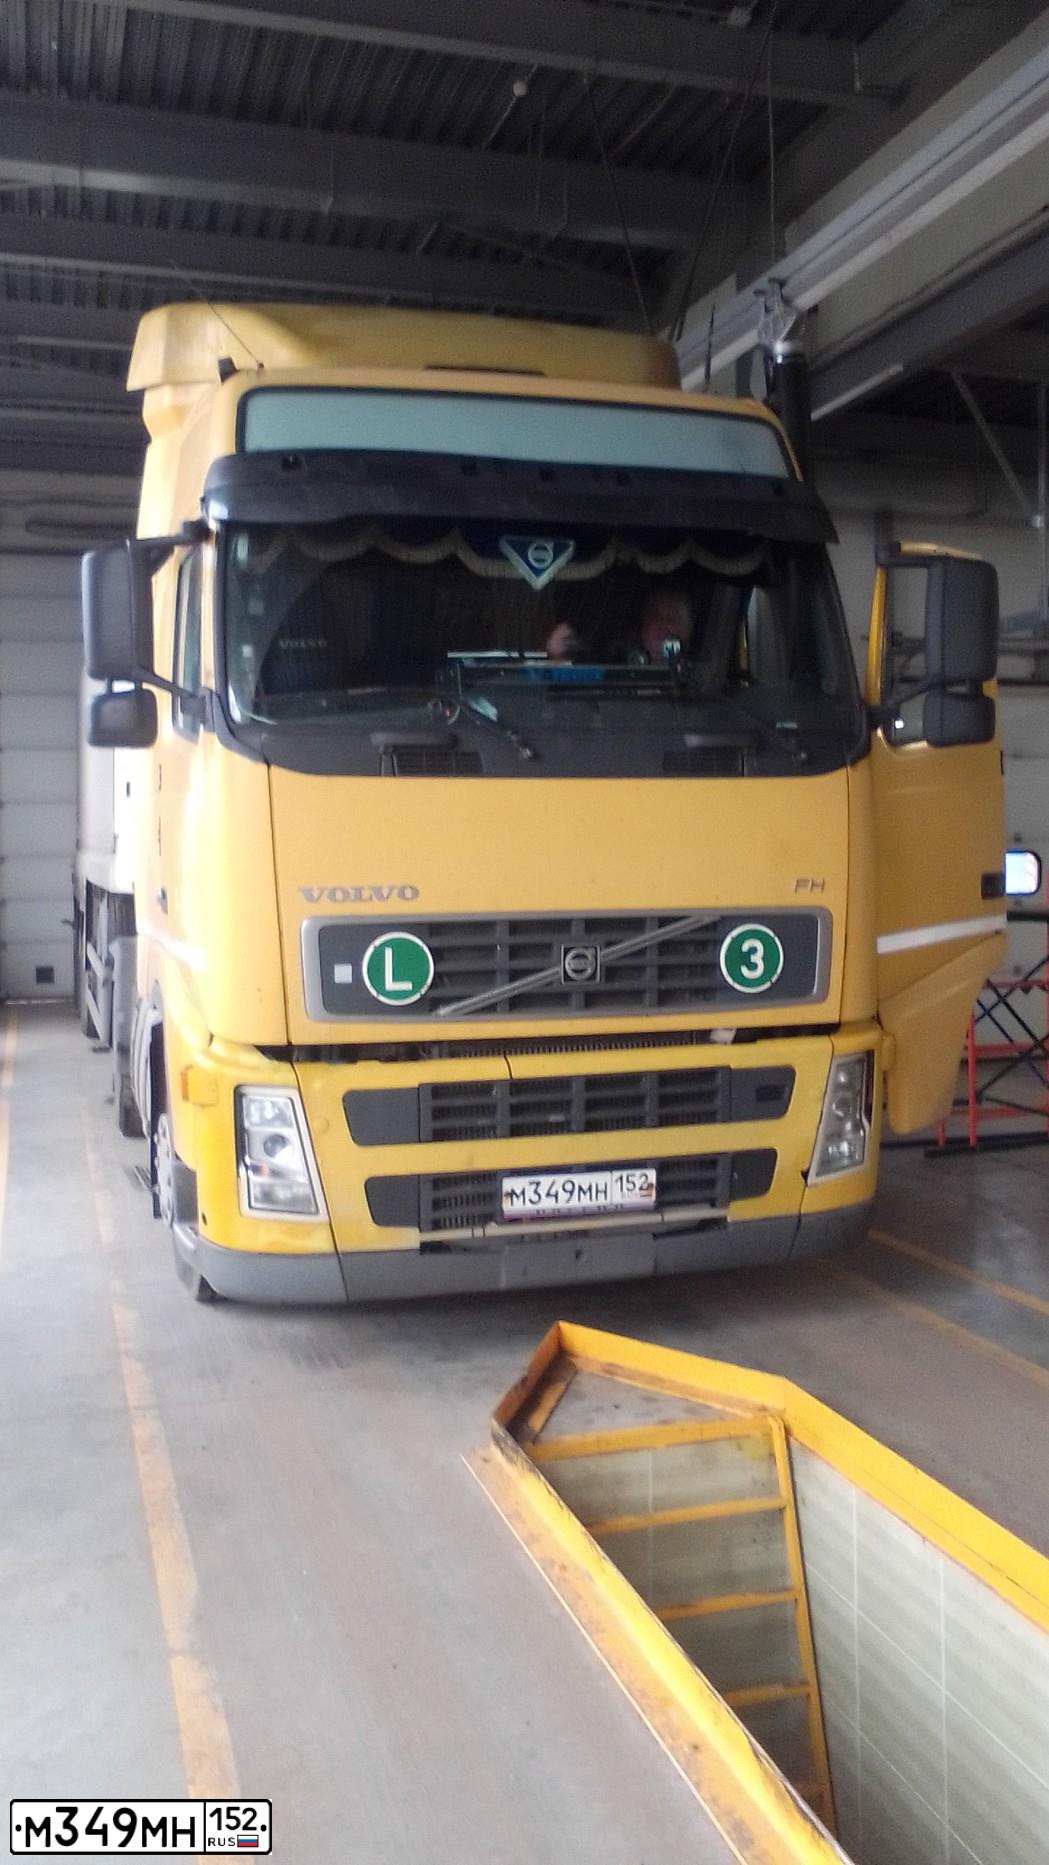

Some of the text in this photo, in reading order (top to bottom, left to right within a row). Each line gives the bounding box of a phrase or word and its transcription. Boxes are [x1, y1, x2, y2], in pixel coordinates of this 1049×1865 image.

[297, 884, 419, 903] VOLVO
[794, 877, 825, 893] FH
[383, 946, 413, 991] L
[741, 939, 765, 979] 3
[615, 1172, 650, 1193] 152
